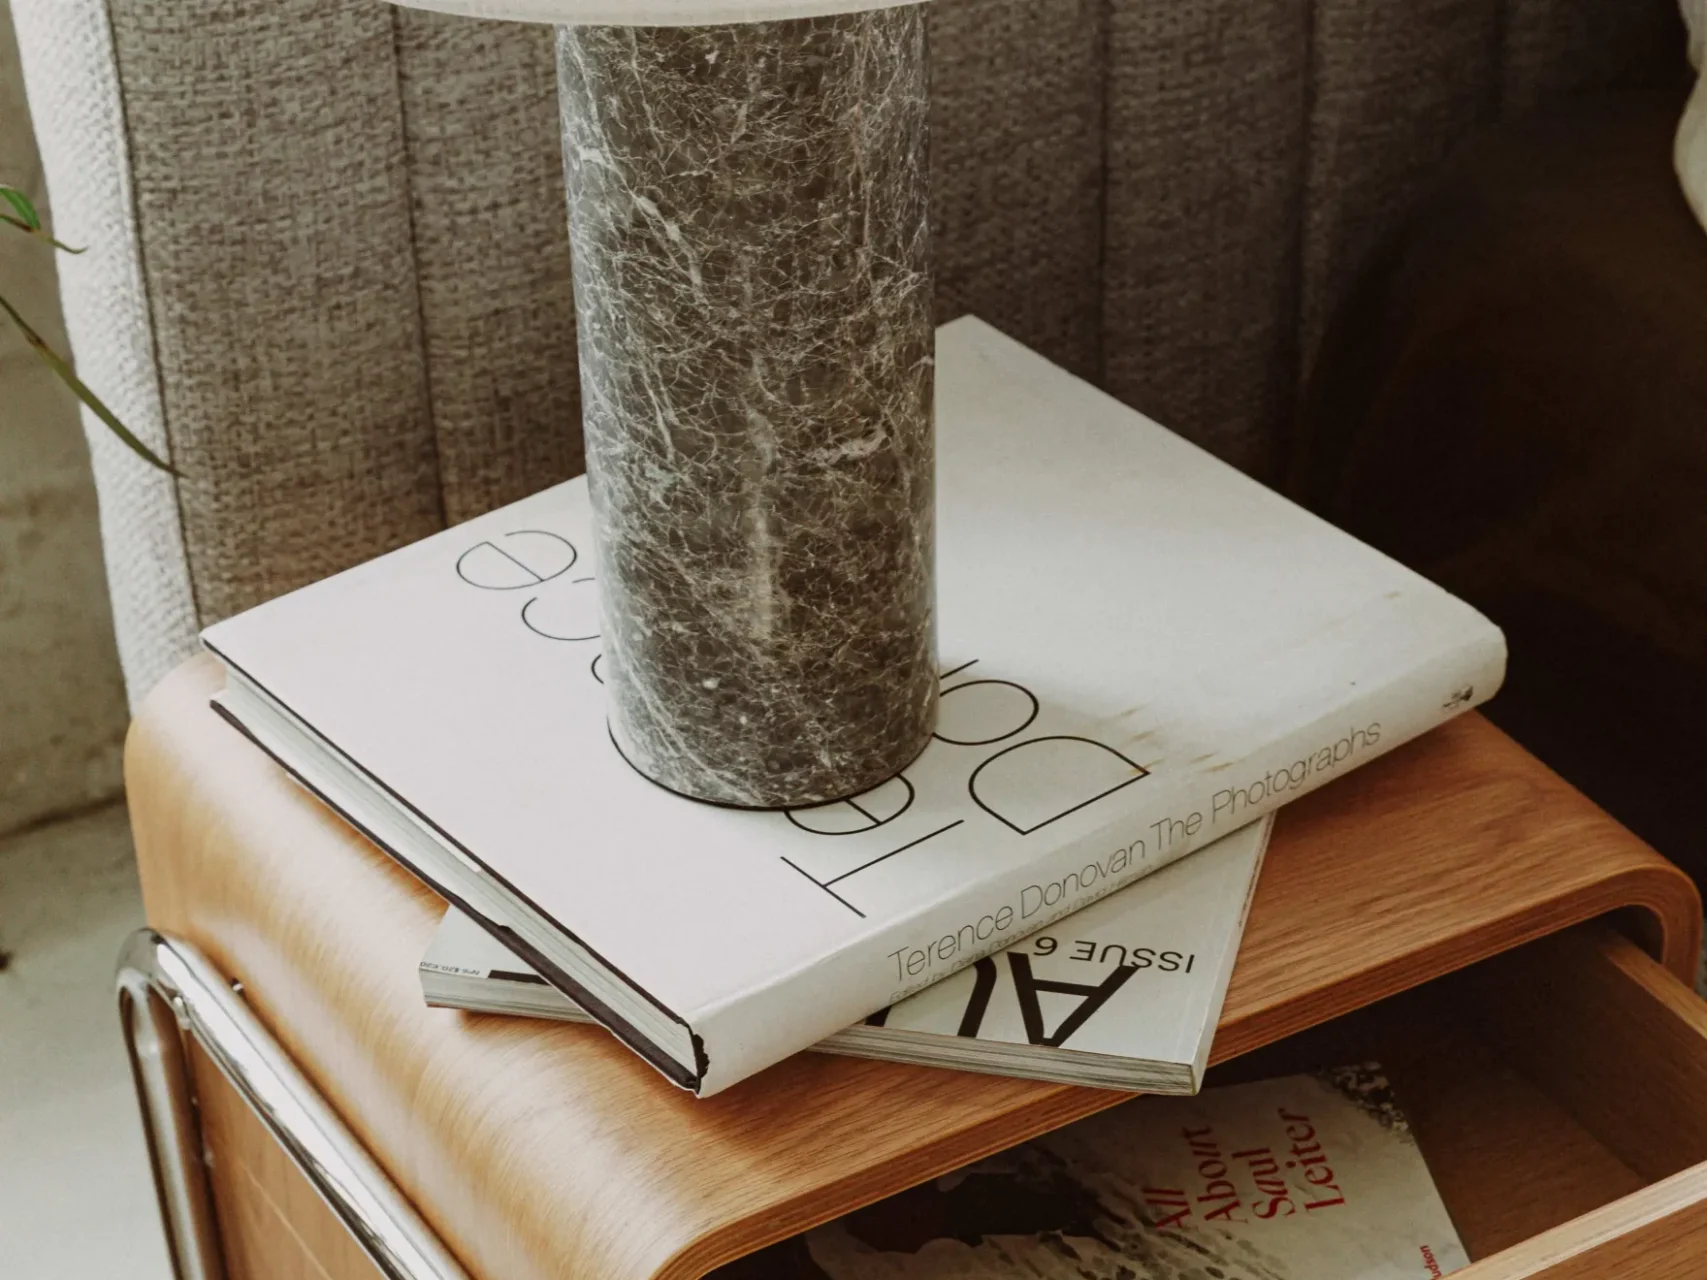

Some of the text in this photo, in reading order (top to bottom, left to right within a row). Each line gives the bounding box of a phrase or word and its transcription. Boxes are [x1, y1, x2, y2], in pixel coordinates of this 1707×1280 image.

[887, 905, 1014, 981] Terence
[1020, 839, 1146, 920] Donovan
[1149, 813, 1204, 851] The
[1211, 721, 1383, 825] Photographs
[1032, 936, 1195, 973] ISSUE 6
[1182, 1125, 1248, 1224] About
[1231, 1147, 1297, 1222] Saul
[1278, 1106, 1346, 1211] Leiter
[1140, 1186, 1194, 1231] All
